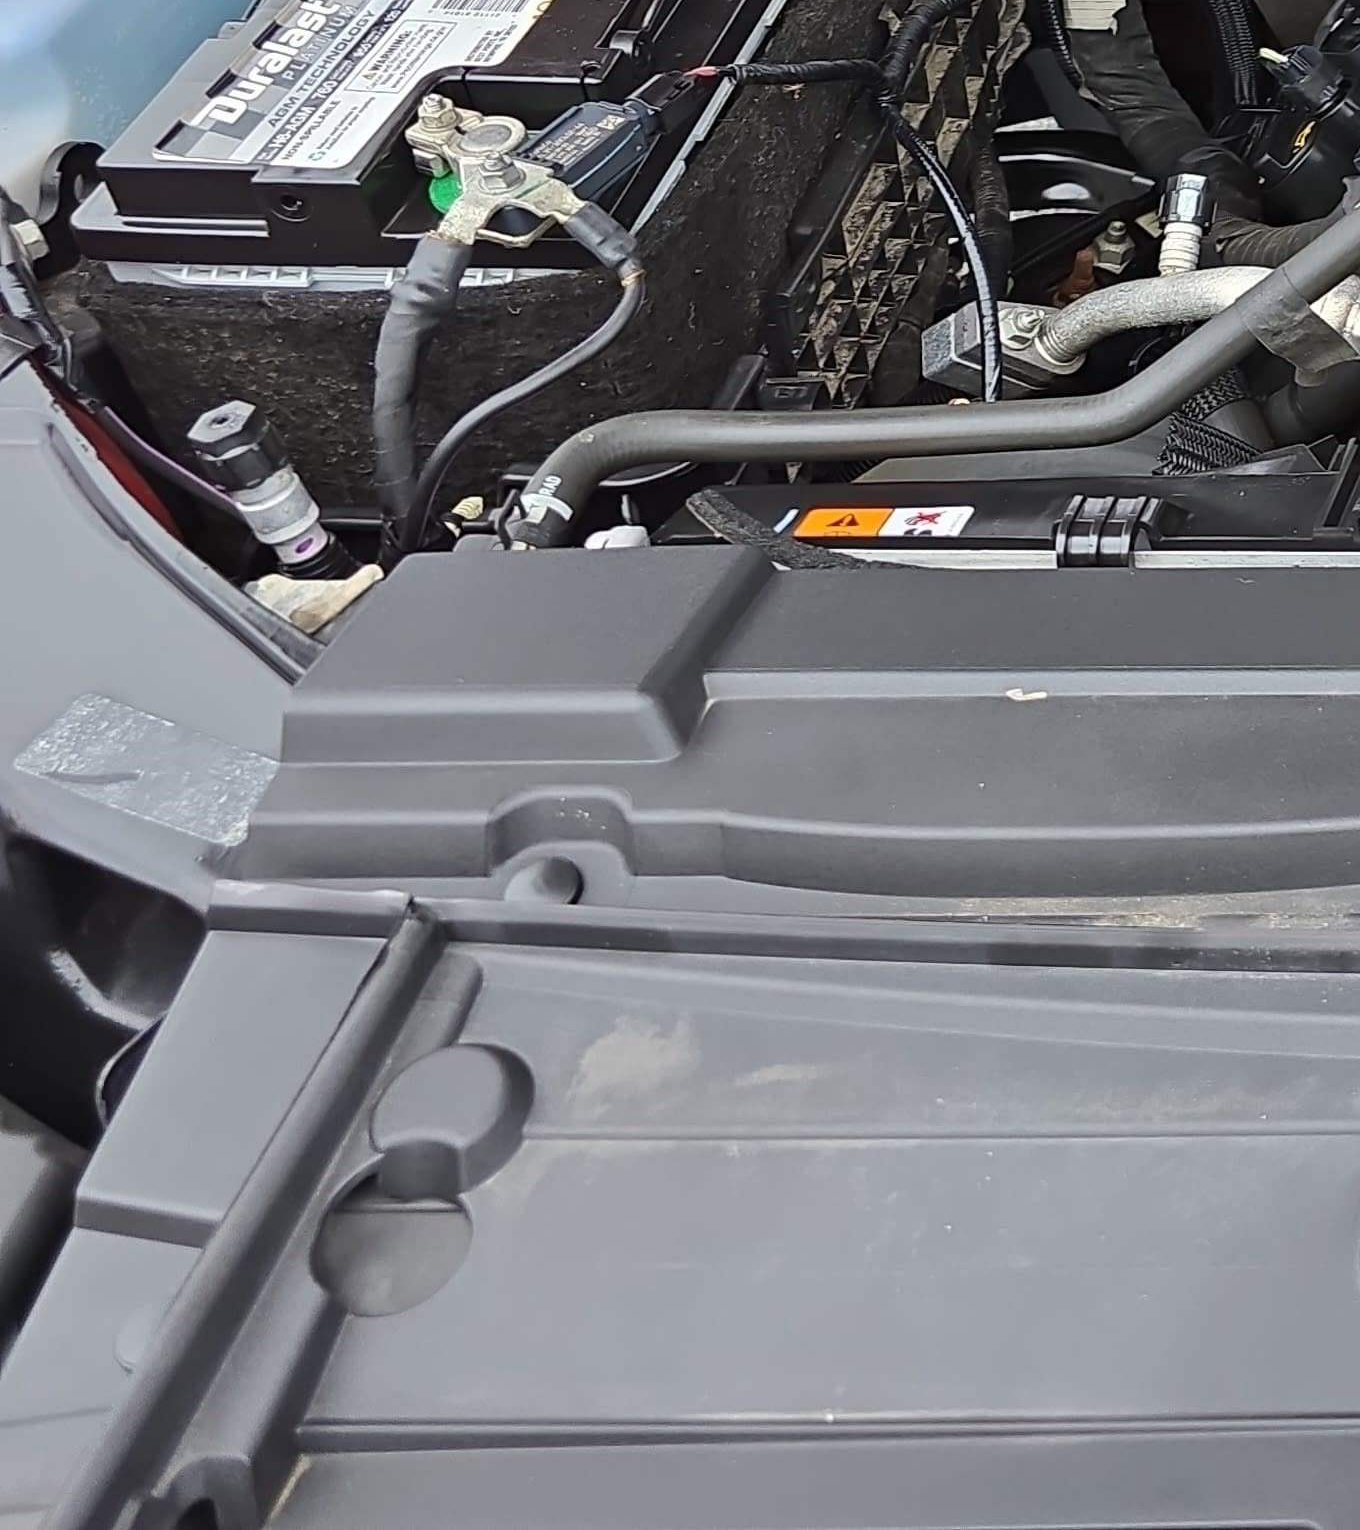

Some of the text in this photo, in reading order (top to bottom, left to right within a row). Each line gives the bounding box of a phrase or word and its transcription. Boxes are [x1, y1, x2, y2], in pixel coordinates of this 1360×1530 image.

[190, 0, 340, 127] Duralast
[268, 9, 374, 127] AGM TECHNOLOGY
[282, 3, 358, 81] PLATINUM
[538, 475, 562, 496] RAD
